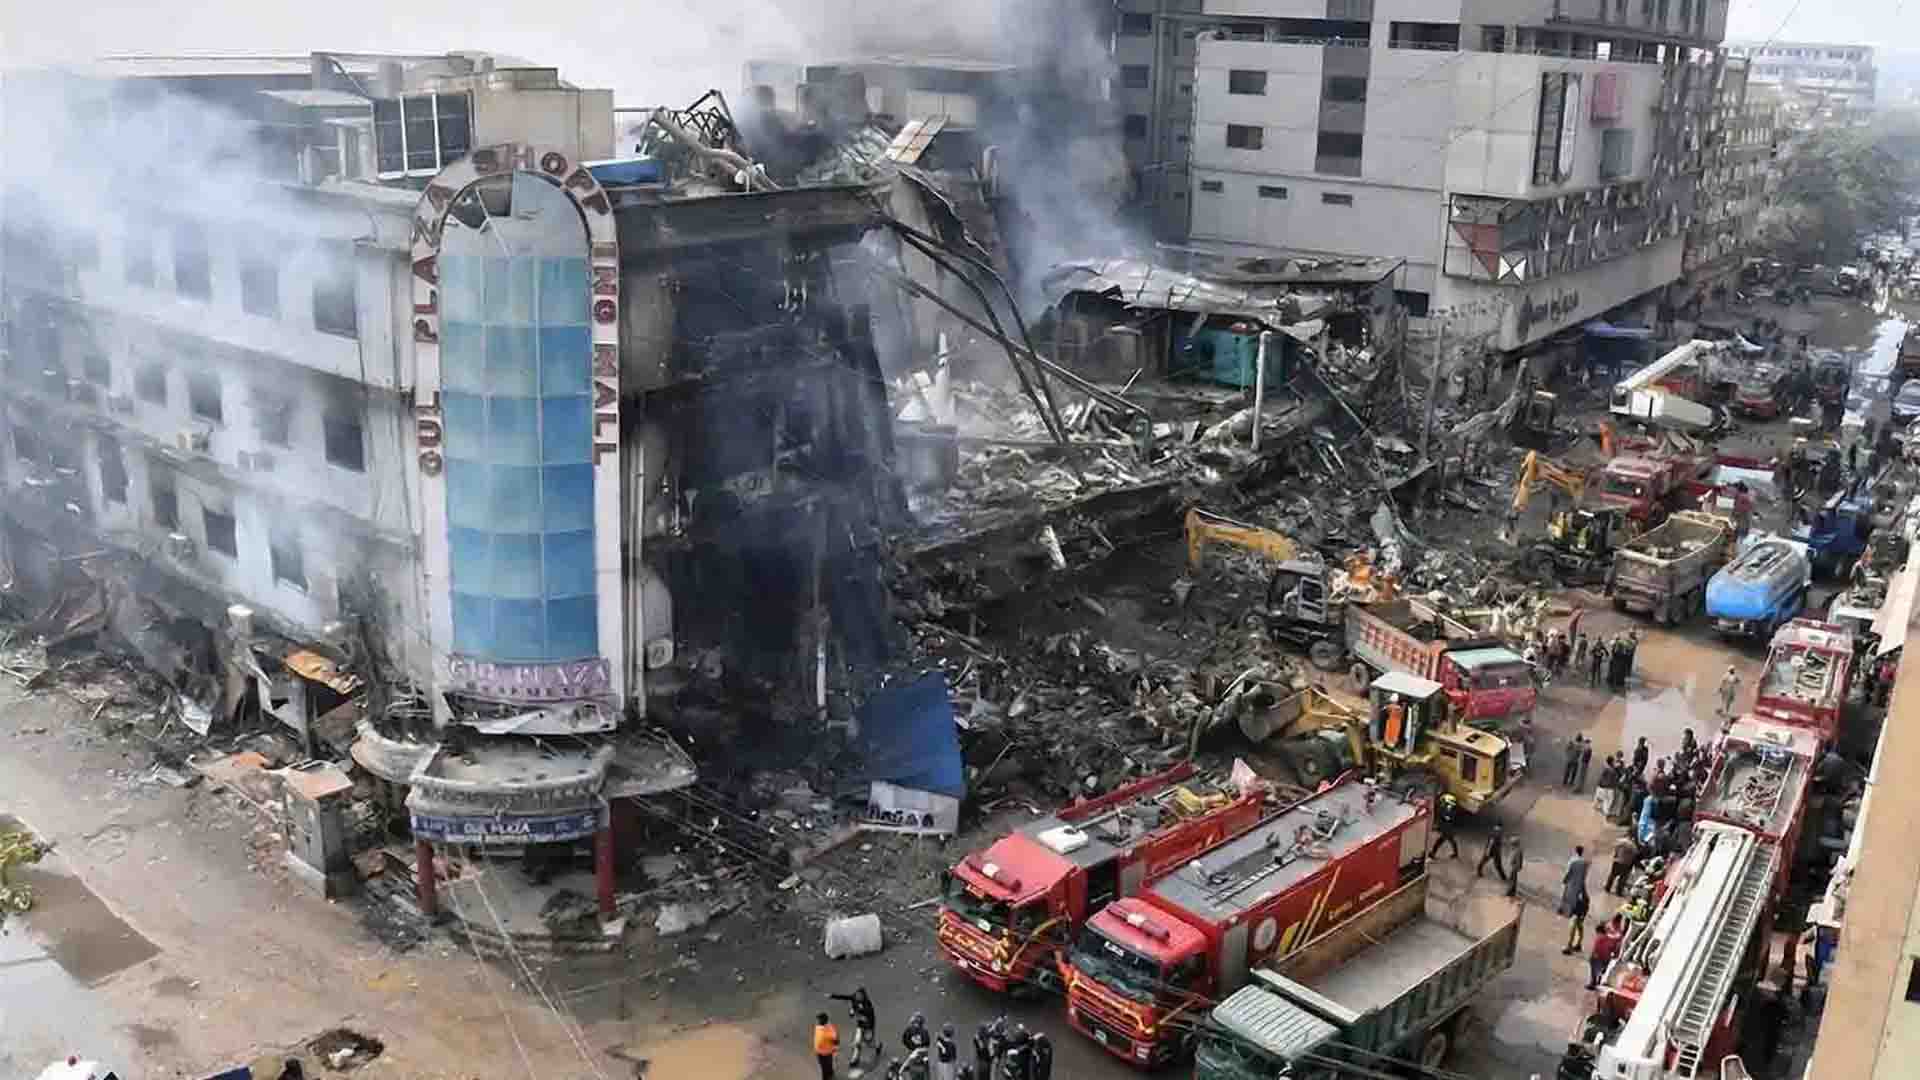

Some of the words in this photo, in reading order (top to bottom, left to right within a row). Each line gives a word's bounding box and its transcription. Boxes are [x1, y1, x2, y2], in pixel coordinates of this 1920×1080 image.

[412, 184, 454, 344] PLAZA
[418, 390, 443, 478] GUL
[593, 343, 617, 466] MALL
